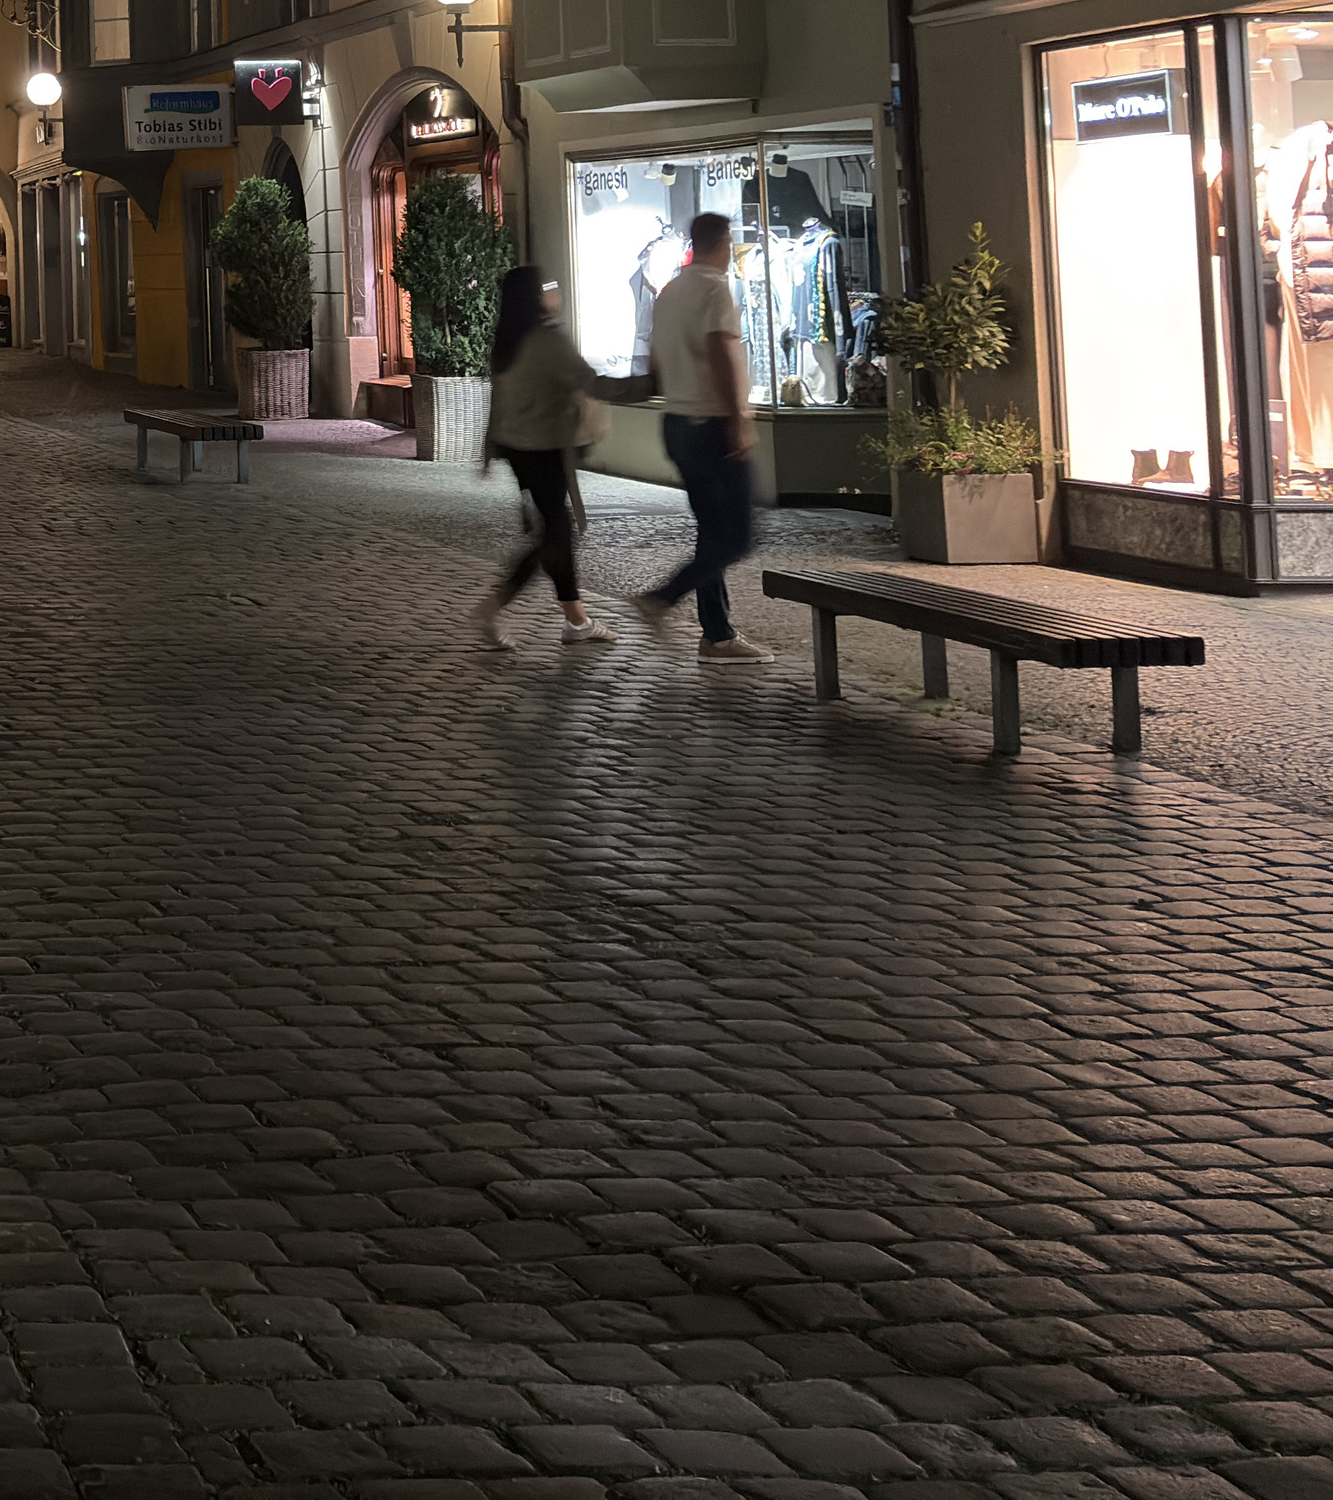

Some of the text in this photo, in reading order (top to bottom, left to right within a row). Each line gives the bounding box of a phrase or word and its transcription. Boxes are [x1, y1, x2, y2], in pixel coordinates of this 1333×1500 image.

[151, 99, 215, 111] Reformhaus
[135, 118, 223, 134] Tobias Stibi
